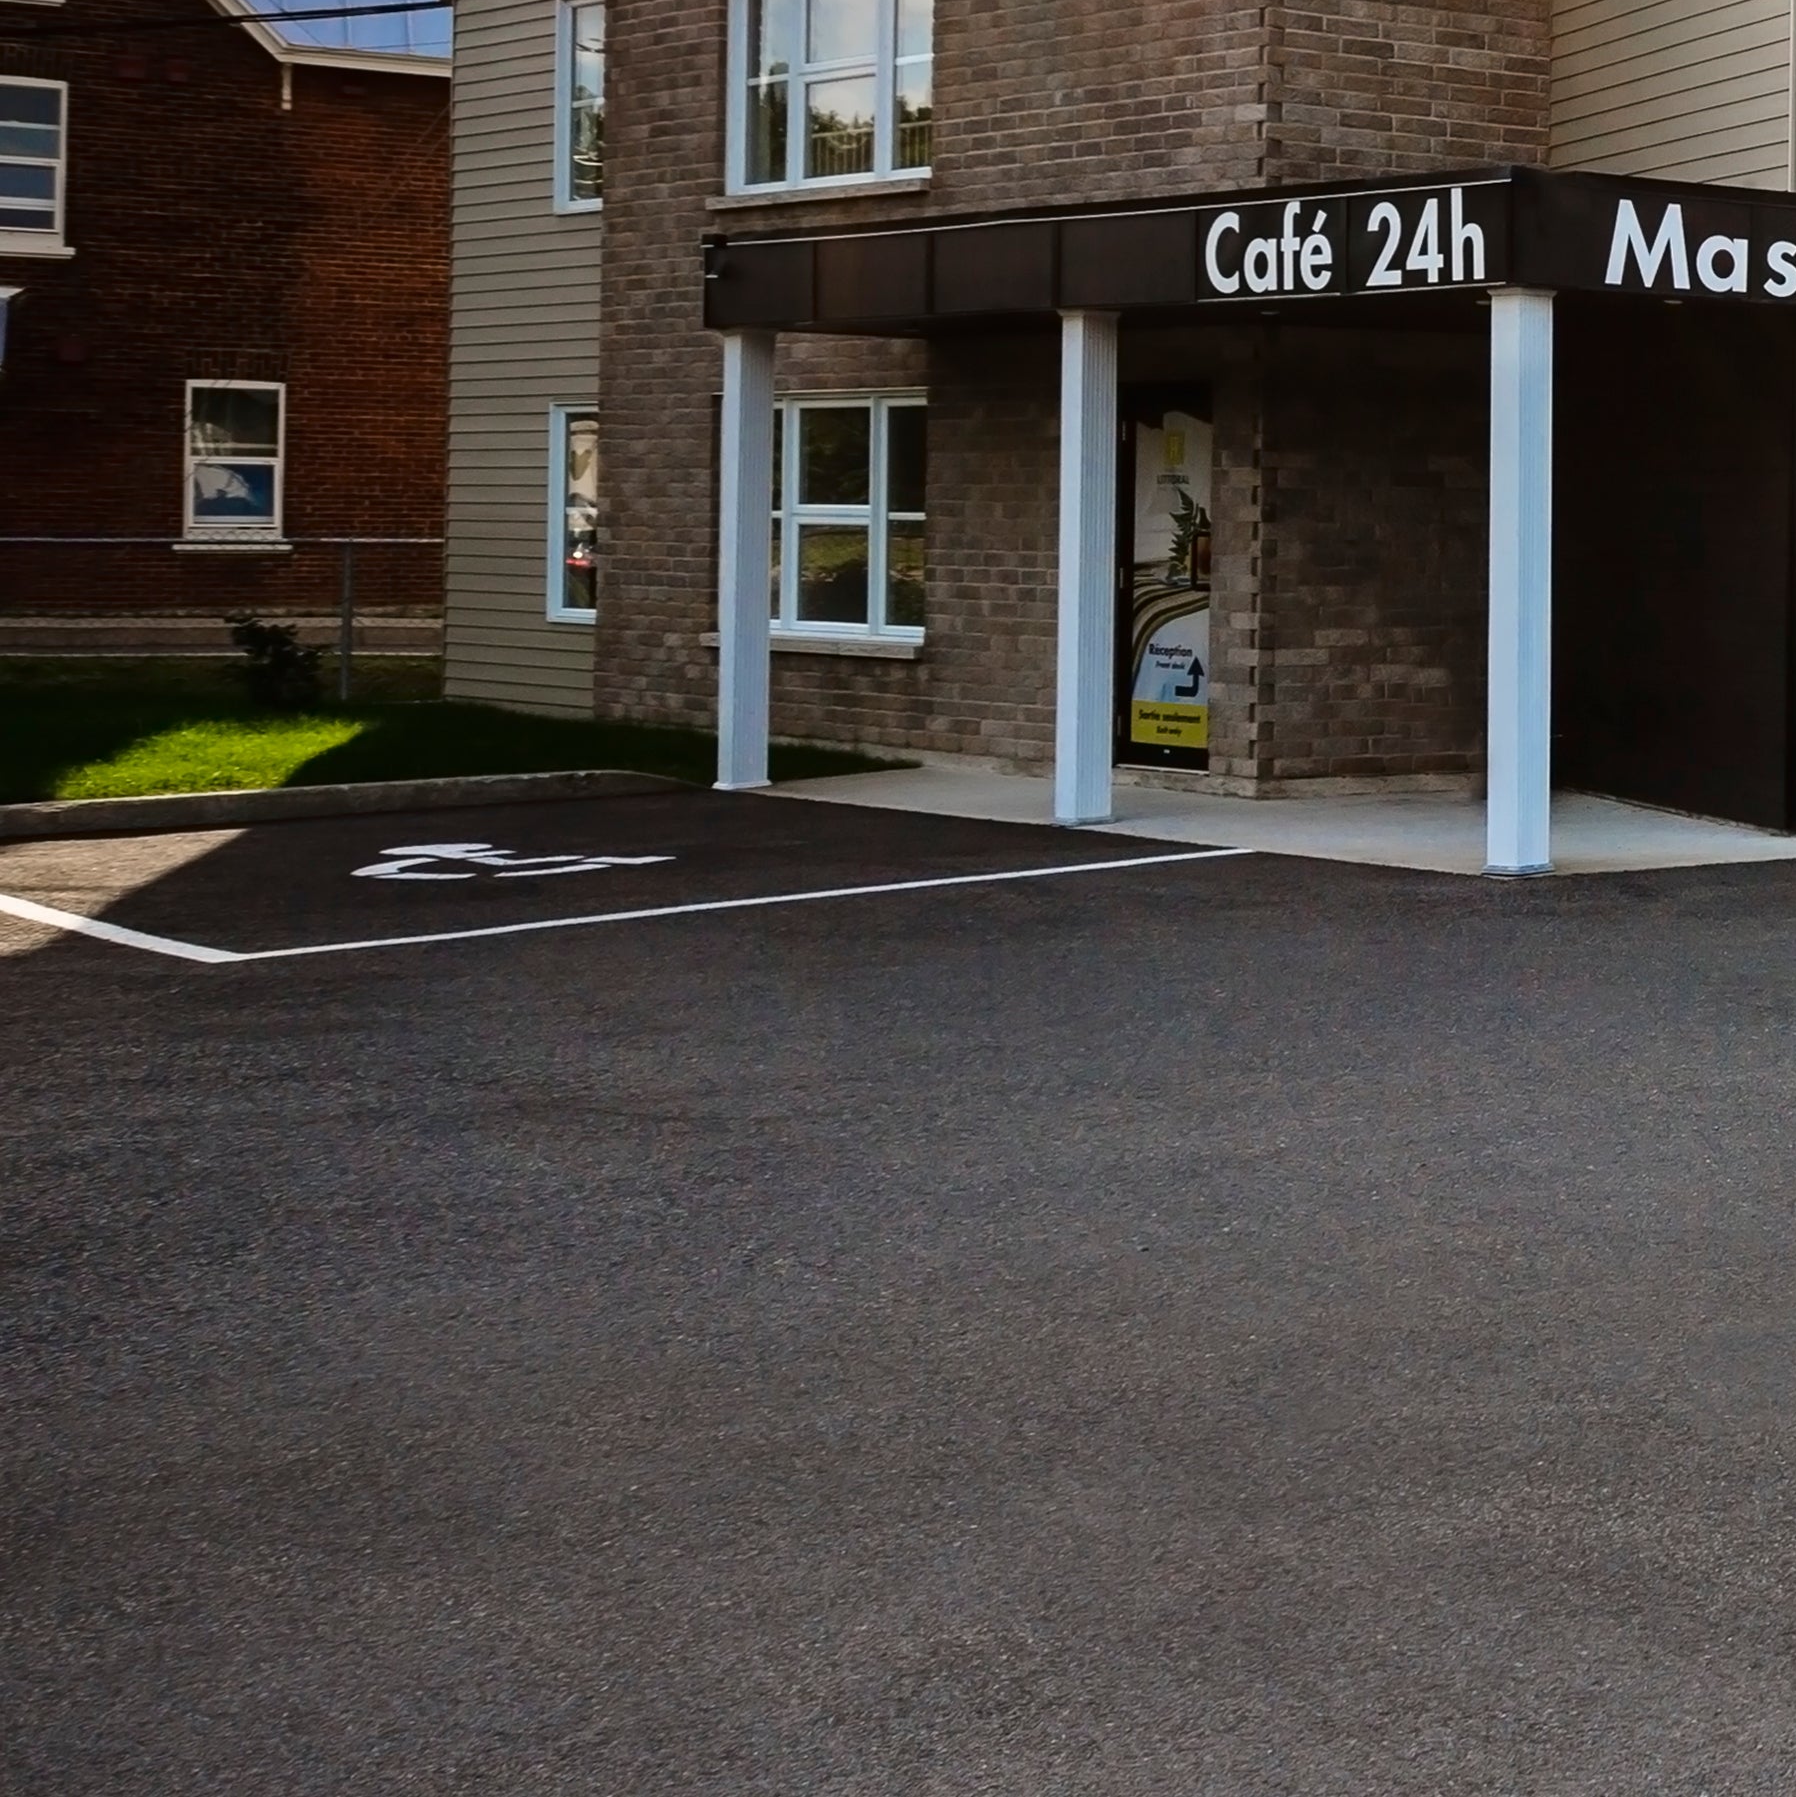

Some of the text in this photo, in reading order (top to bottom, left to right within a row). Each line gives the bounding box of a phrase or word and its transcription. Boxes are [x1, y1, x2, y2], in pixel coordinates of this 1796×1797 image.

[1204, 188, 1486, 294] Café 24h
[1149, 644, 1193, 659] Réception
